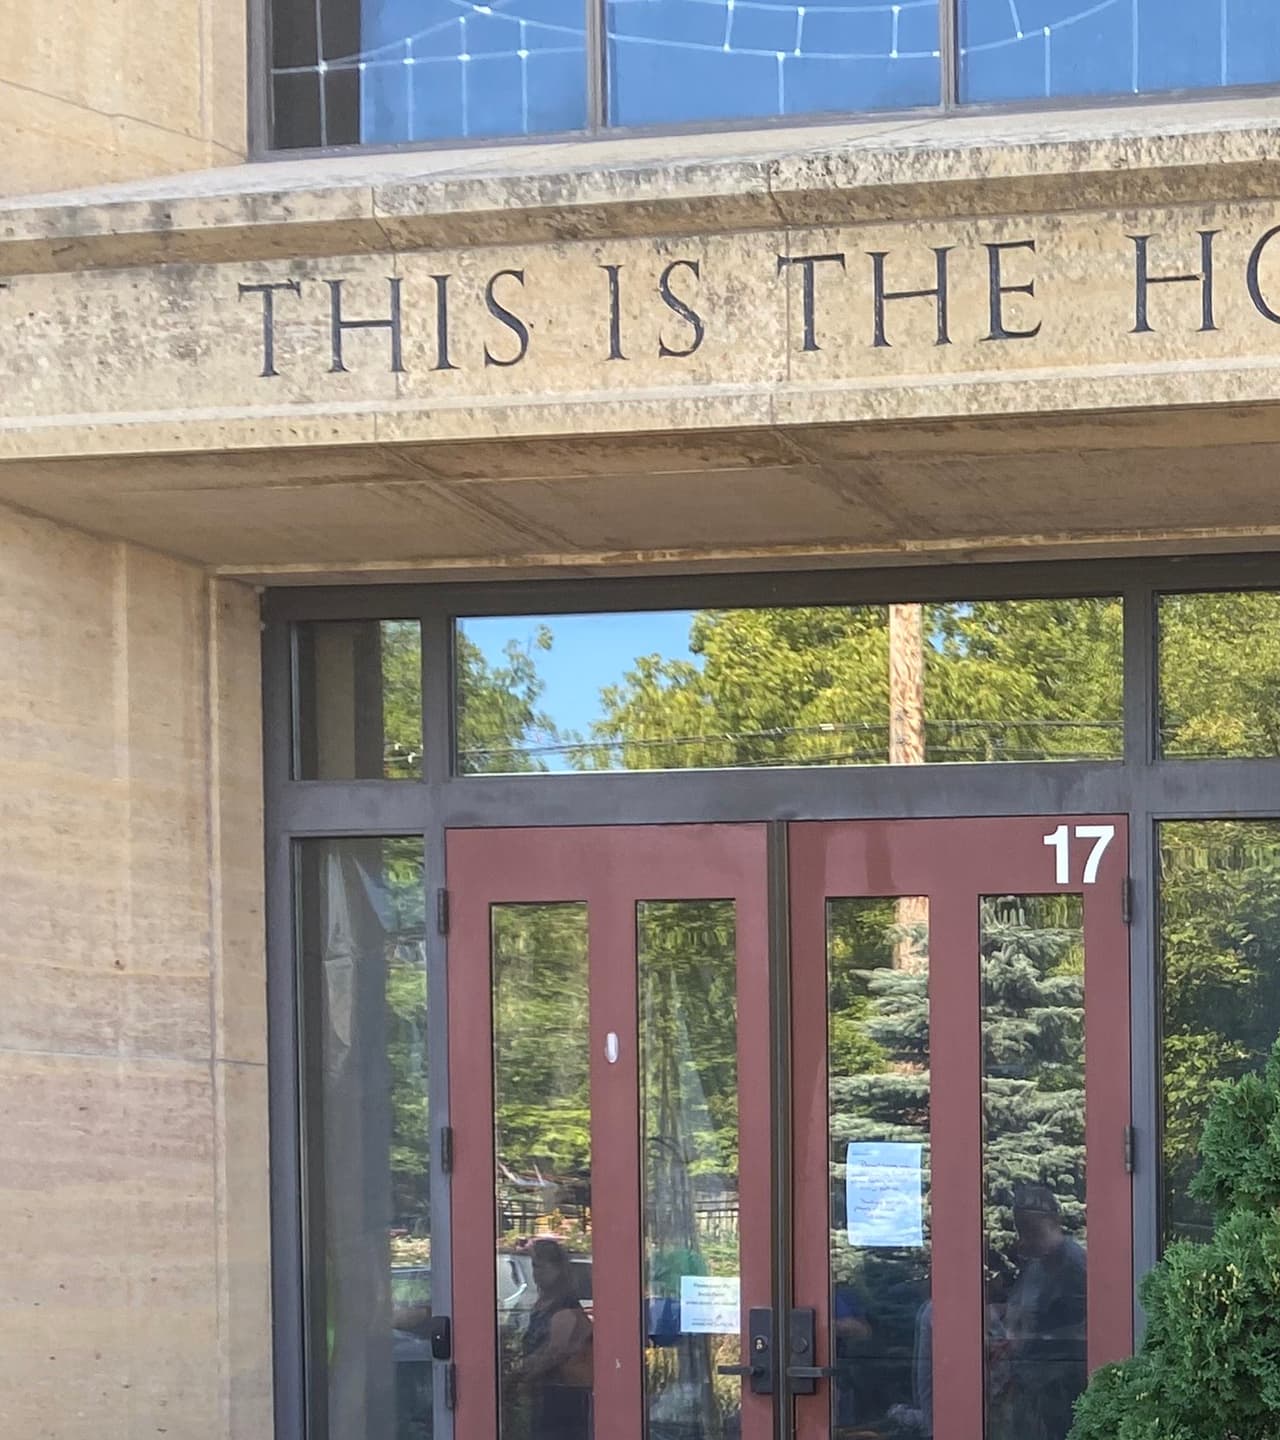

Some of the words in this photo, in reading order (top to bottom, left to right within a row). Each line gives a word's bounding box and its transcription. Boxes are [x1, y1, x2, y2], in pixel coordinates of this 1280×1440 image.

[237, 267, 531, 377] THIS
[599, 259, 706, 362] IS
[777, 239, 1043, 352] THE
[1043, 825, 1115, 884] 17
